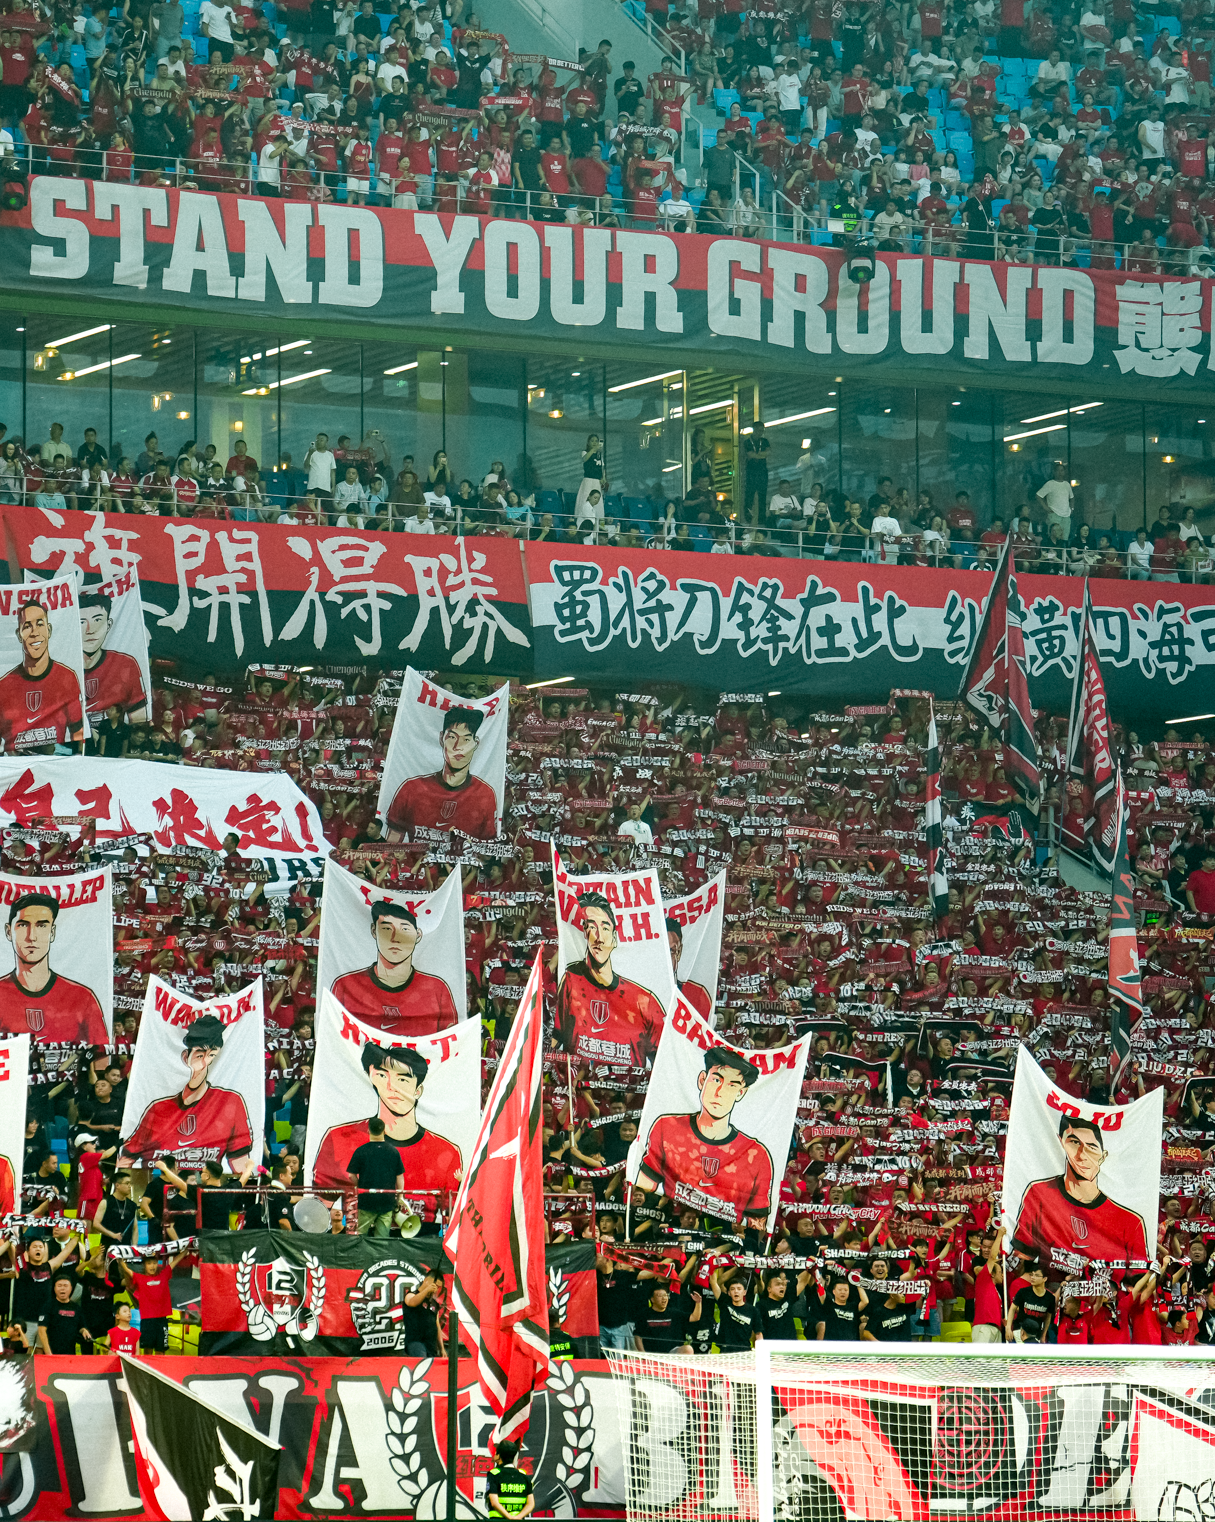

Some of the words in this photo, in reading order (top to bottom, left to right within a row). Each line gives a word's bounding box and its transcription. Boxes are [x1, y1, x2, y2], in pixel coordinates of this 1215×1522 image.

[29, 175, 384, 309] STAND
[414, 211, 684, 333] YOUR
[707, 238, 1096, 366] GROUND
[163, 676, 196, 691] REDS
[196, 684, 216, 693] WE
[217, 686, 233, 694] GO
[577, 1034, 632, 1059] 成都蓉城
[674, 1180, 738, 1216] 成都蓉城
[824, 1249, 869, 1260] SHADOW
[877, 1249, 911, 1260] GHOST
[367, 1258, 399, 1275] DECADES
[365, 1335, 395, 1347] 2006
[498, 1482, 527, 1496] 秩序维护
